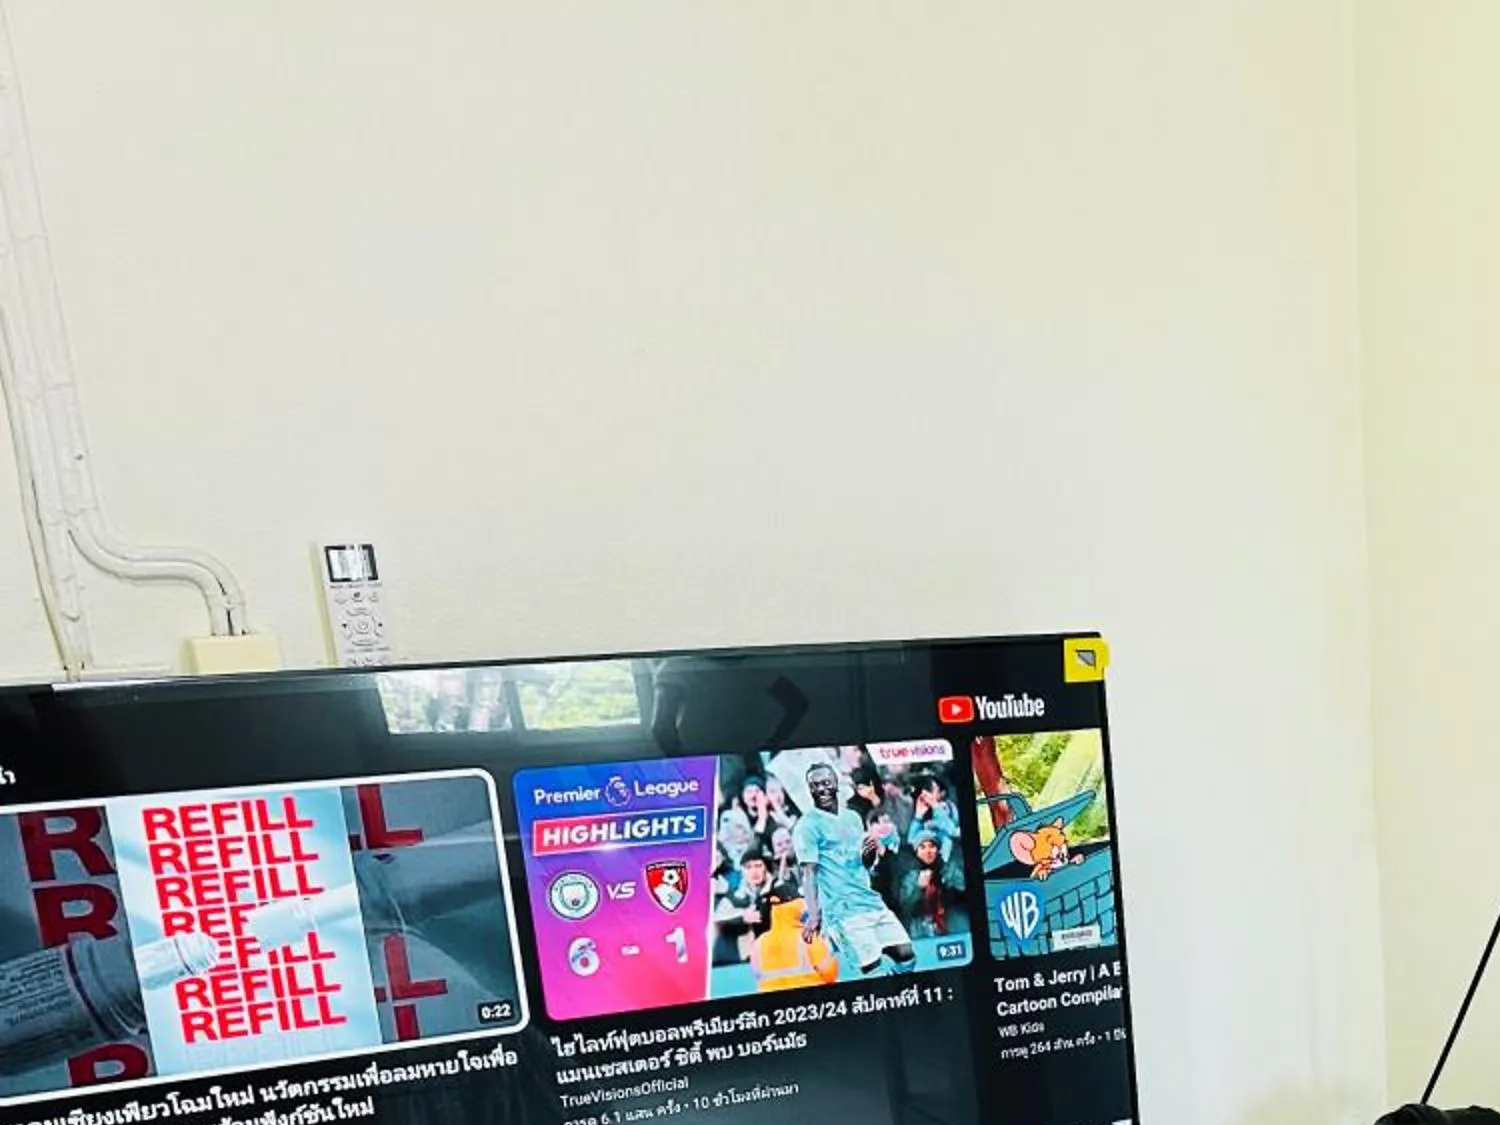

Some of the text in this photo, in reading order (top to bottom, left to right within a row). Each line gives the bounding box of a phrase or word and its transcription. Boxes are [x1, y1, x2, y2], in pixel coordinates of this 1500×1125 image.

[975, 693, 1045, 720] YouTube
[534, 779, 699, 805] Premier League
[142, 796, 314, 841] REFILL
[543, 815, 697, 847] HIGHLIGHTS
[148, 831, 319, 875] REFILL
[155, 864, 324, 910] REFILL
[1001, 891, 1040, 940] WB
[568, 937, 600, 977] 6
[665, 927, 688, 964] 1
[938, 943, 963, 959] 9:31
[175, 963, 341, 1011] REFILL
[994, 976, 1030, 993] Tom
[1033, 972, 1045, 987] &
[1048, 966, 1087, 985] Jerry
[1098, 963, 1110, 978] A
[181, 995, 347, 1044] REFILL
[481, 1003, 512, 1020] 0:22
[773, 1000, 848, 1027] 2023/24
[923, 987, 943, 1004] 11
[996, 995, 1057, 1016] Cartoon
[560, 1075, 690, 1109] TrueVisionsOfficial
[693, 1096, 710, 1110] 10
